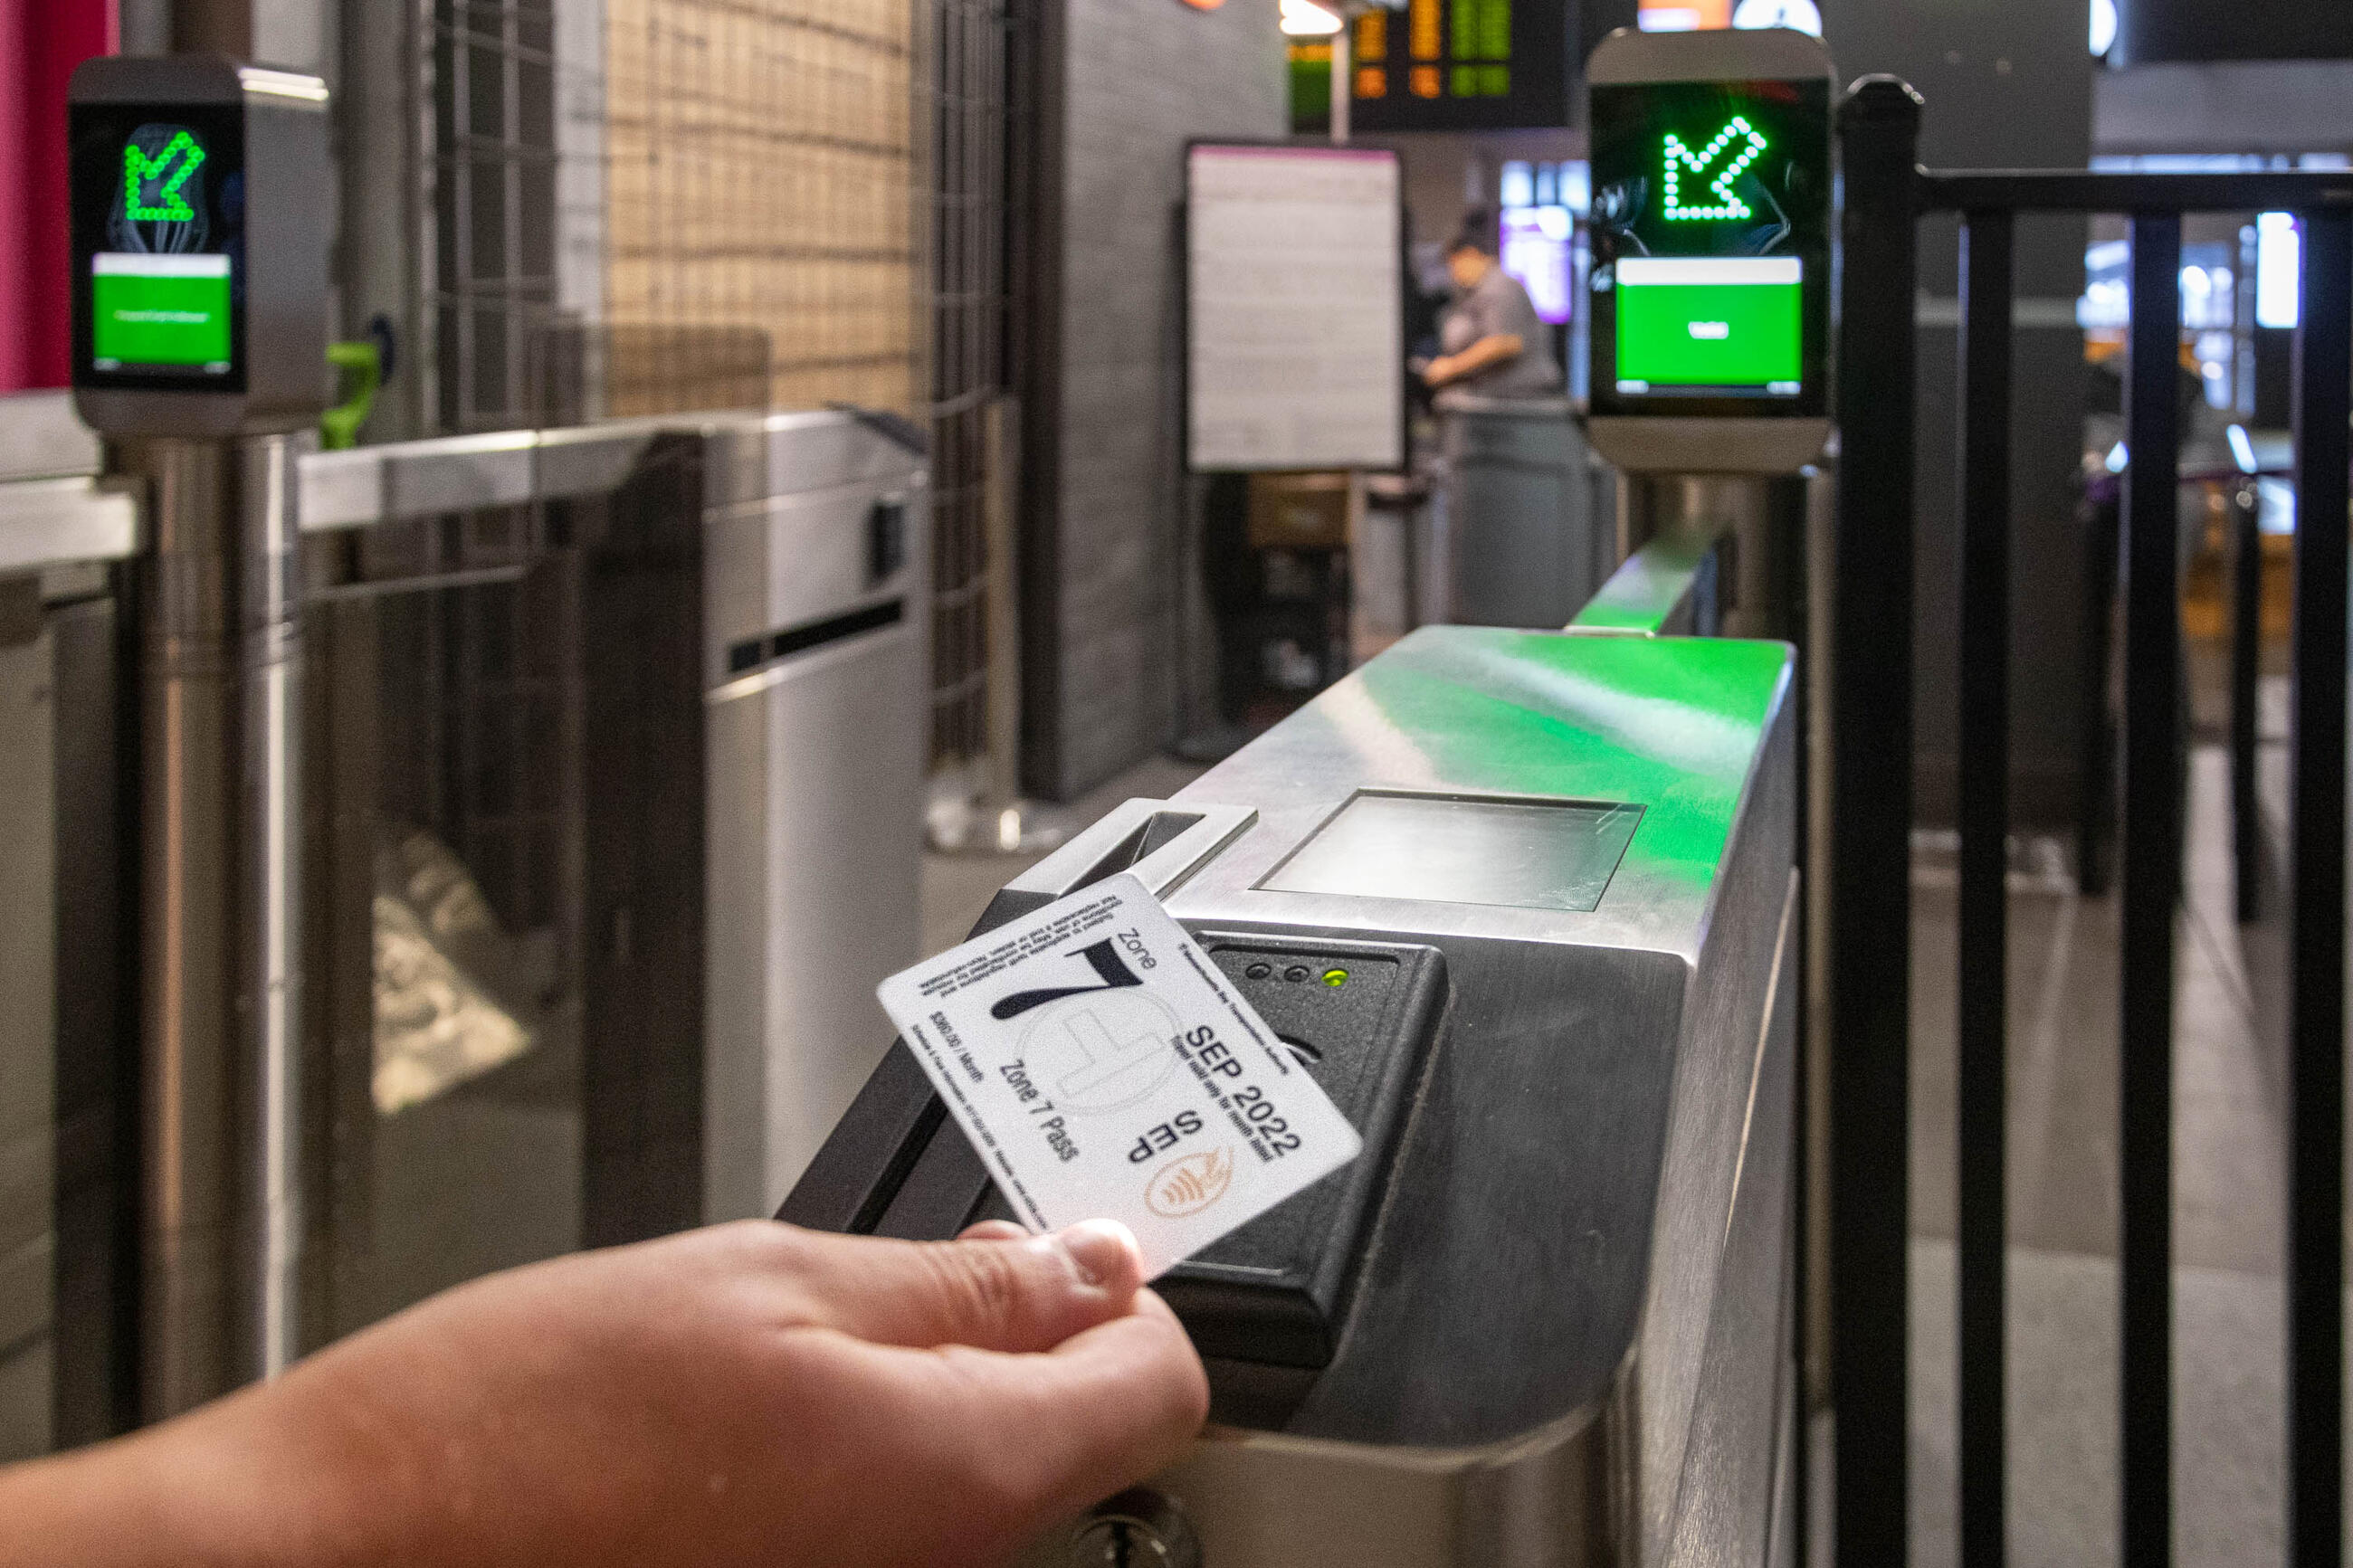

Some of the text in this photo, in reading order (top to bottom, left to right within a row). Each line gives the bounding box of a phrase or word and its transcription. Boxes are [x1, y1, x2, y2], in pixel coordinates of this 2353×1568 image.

[1117, 927, 1157, 971] Zone
[989, 936, 1144, 1022] 7
[998, 1058, 1040, 1104] Zone
[1185, 1024, 1302, 1157] SEP 2022
[1029, 1099, 1055, 1116] 7
[1039, 1116, 1080, 1163] Pass
[1128, 1109, 1204, 1164] SEP
